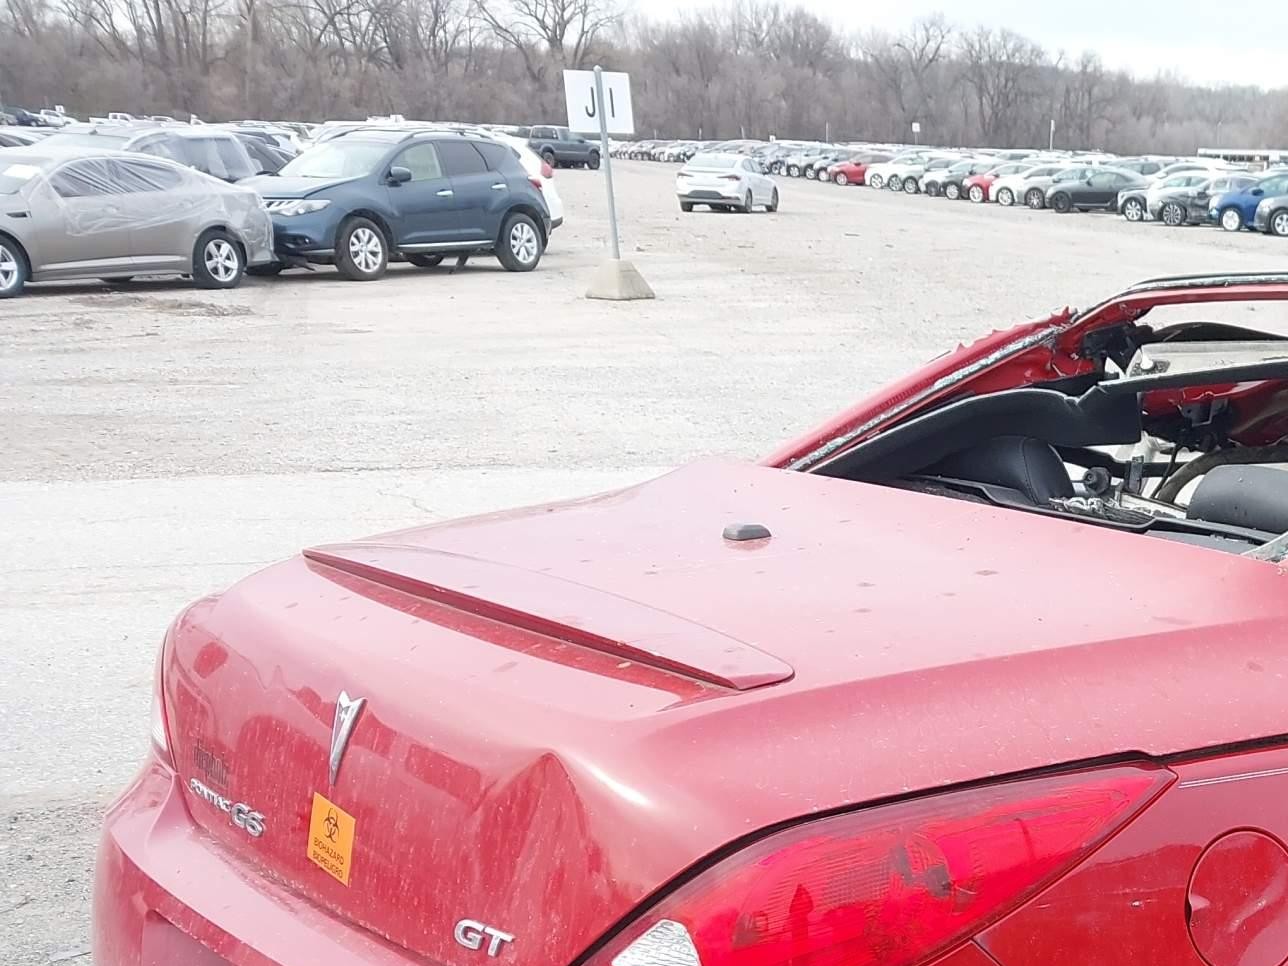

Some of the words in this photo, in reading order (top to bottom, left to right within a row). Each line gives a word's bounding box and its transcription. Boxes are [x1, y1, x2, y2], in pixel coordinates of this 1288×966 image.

[231, 802, 266, 837] G6
[312, 850, 344, 878] BIOPELIGRO
[313, 837, 345, 865] BIOHAZARD
[454, 918, 516, 957] GT
